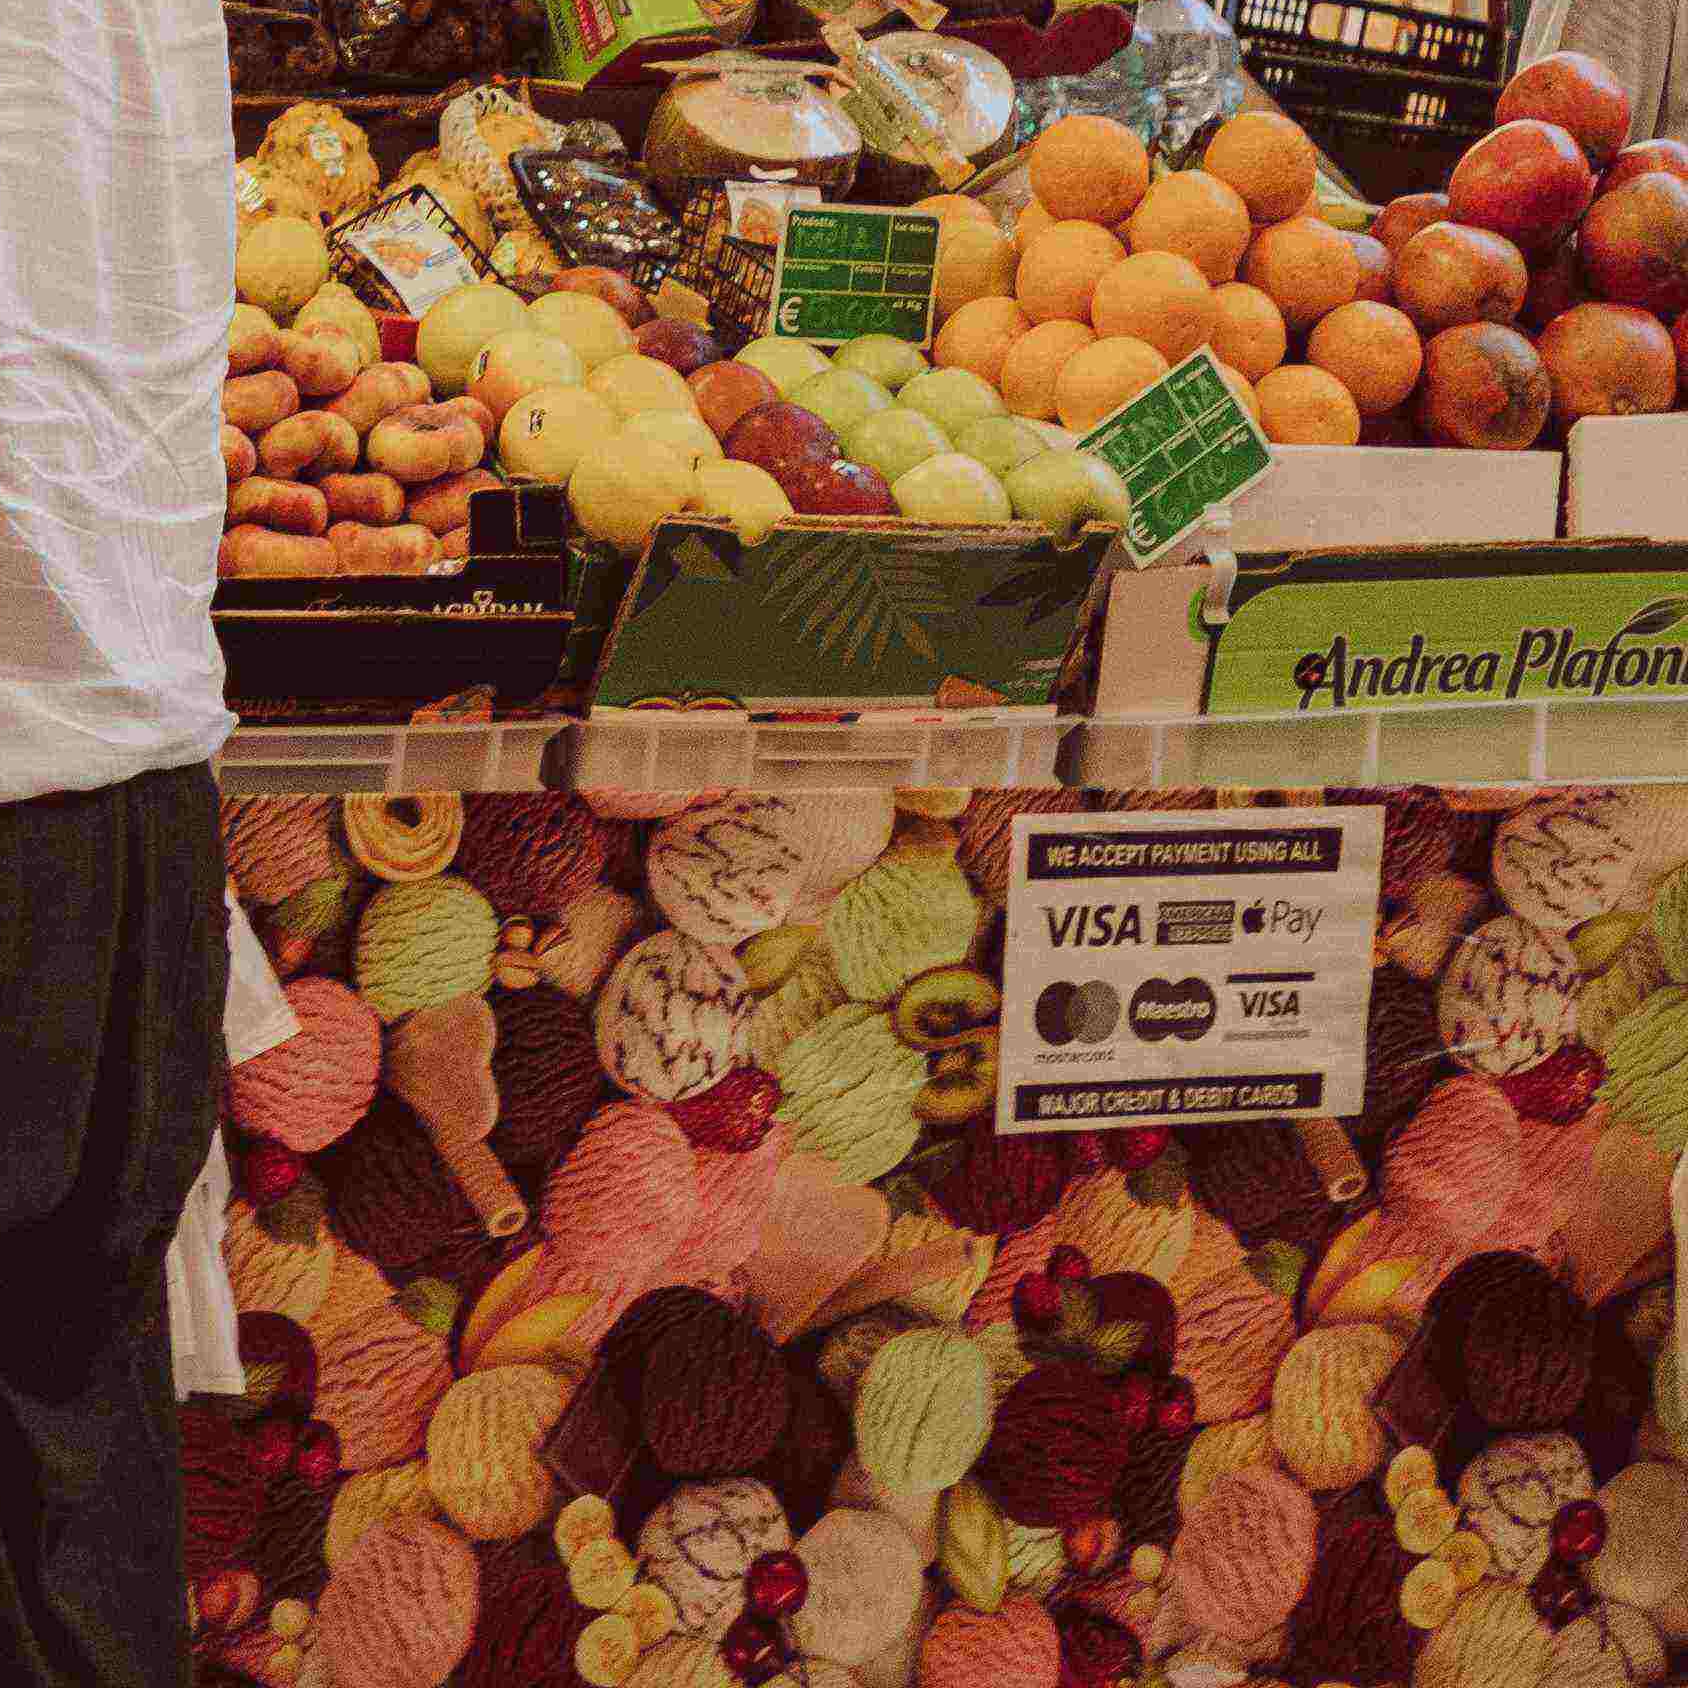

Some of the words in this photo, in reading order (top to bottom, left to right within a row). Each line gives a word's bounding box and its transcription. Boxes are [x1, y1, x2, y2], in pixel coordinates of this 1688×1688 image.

[1293, 632, 1500, 710] Andrea
[1047, 845, 1073, 868] WE
[1079, 844, 1148, 866] ACCEPT
[1152, 841, 1230, 865] PAYMENT
[1234, 841, 1288, 863] USING
[1290, 840, 1322, 862] ALL
[1040, 904, 1143, 948] VISA
[1270, 899, 1324, 944] Pay
[1238, 990, 1299, 1018] VISA
[1038, 1092, 1099, 1115] MAJOR
[1103, 1089, 1165, 1113] CREDIT
[1184, 1086, 1235, 1109] DEBIT
[1238, 1084, 1299, 1107] CARDS
